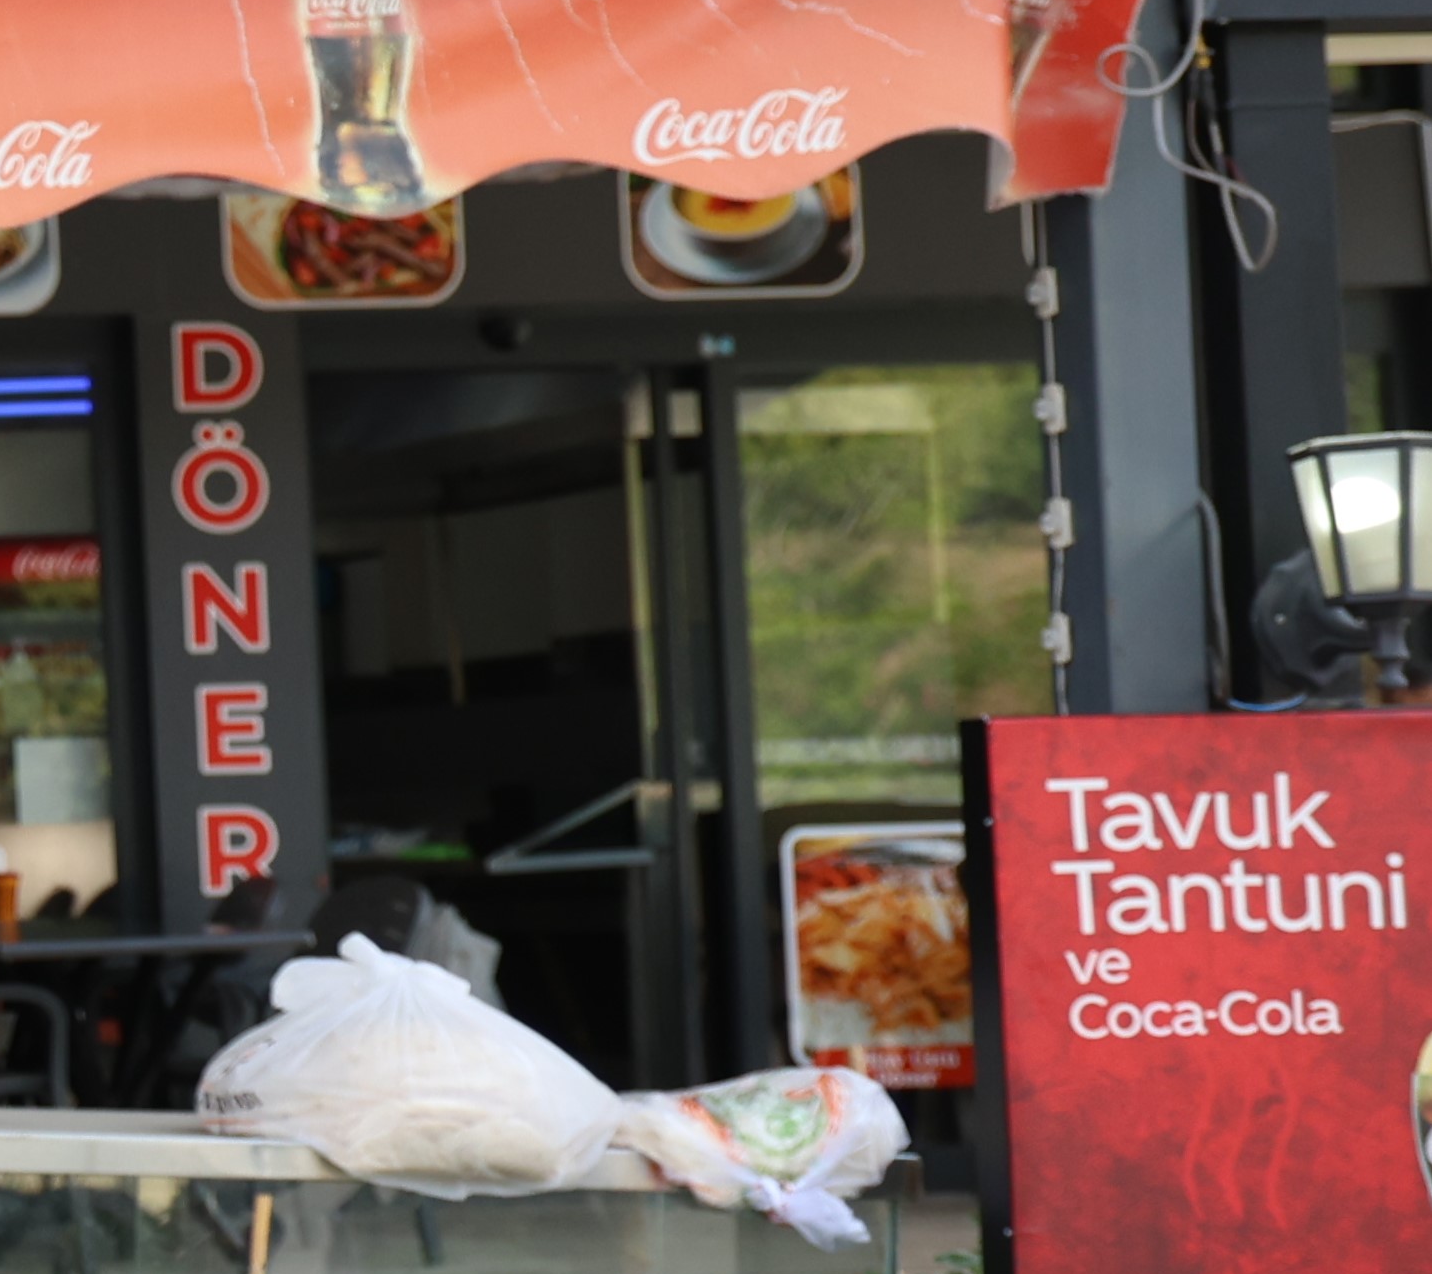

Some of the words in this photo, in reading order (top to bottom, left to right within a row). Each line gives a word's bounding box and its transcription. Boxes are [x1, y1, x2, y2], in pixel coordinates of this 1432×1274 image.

[633, 86, 850, 165] Coca-Cola
[172, 321, 280, 897] DÖNER
[1046, 773, 1335, 851] Tavuk
[1052, 853, 1407, 935] Tantuni
[1066, 948, 1131, 986] ve
[1068, 989, 1342, 1038] Coca-Cola
